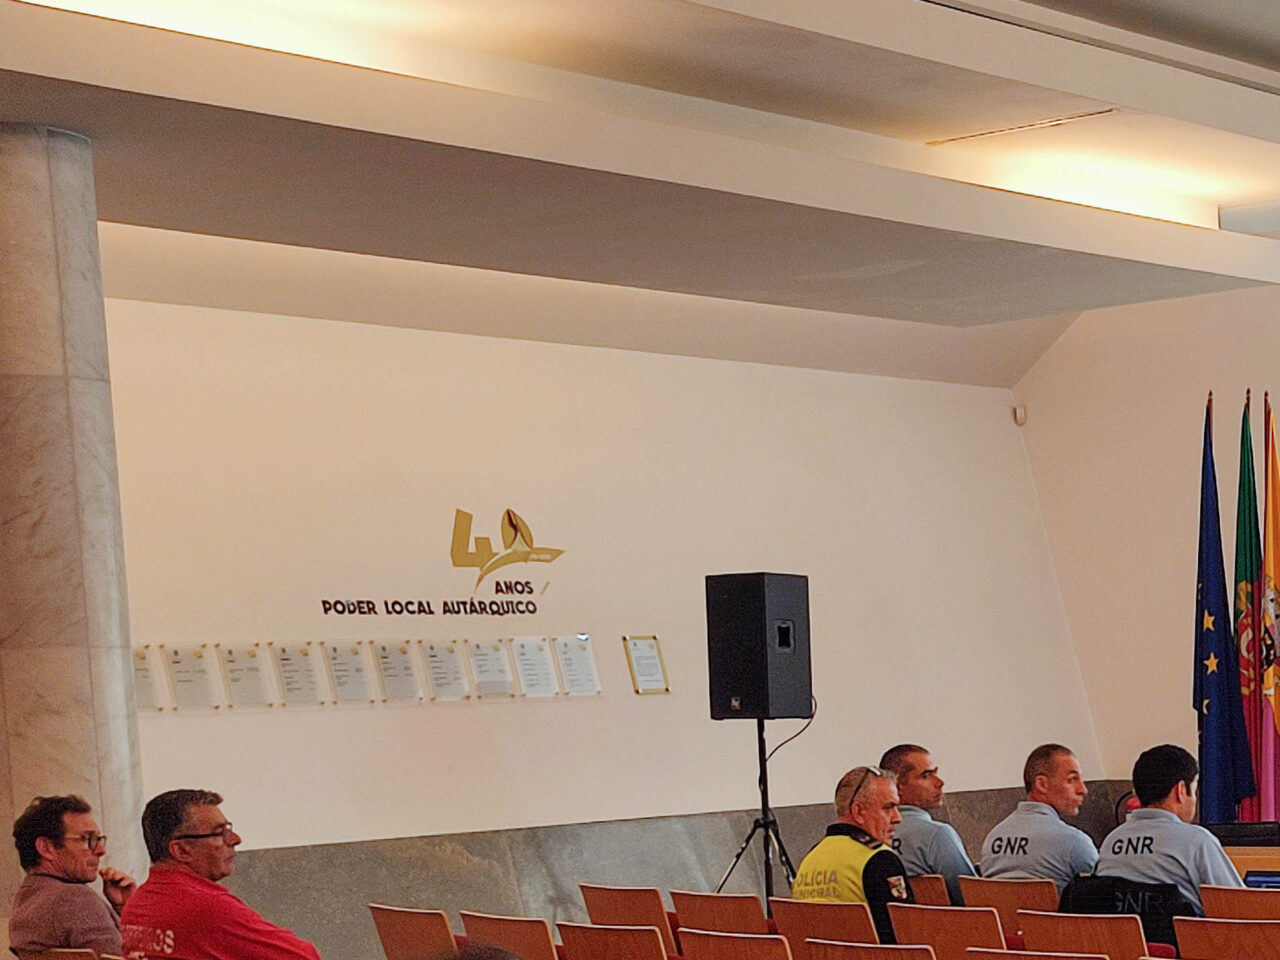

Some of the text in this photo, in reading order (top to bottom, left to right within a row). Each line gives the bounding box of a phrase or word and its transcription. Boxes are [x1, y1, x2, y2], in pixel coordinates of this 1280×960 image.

[495, 580, 534, 595] ANOS
[321, 597, 537, 616] PODER LOCAL AUTÁRQUICO
[991, 837, 1029, 855] GNR
[1111, 836, 1154, 855] GNR
